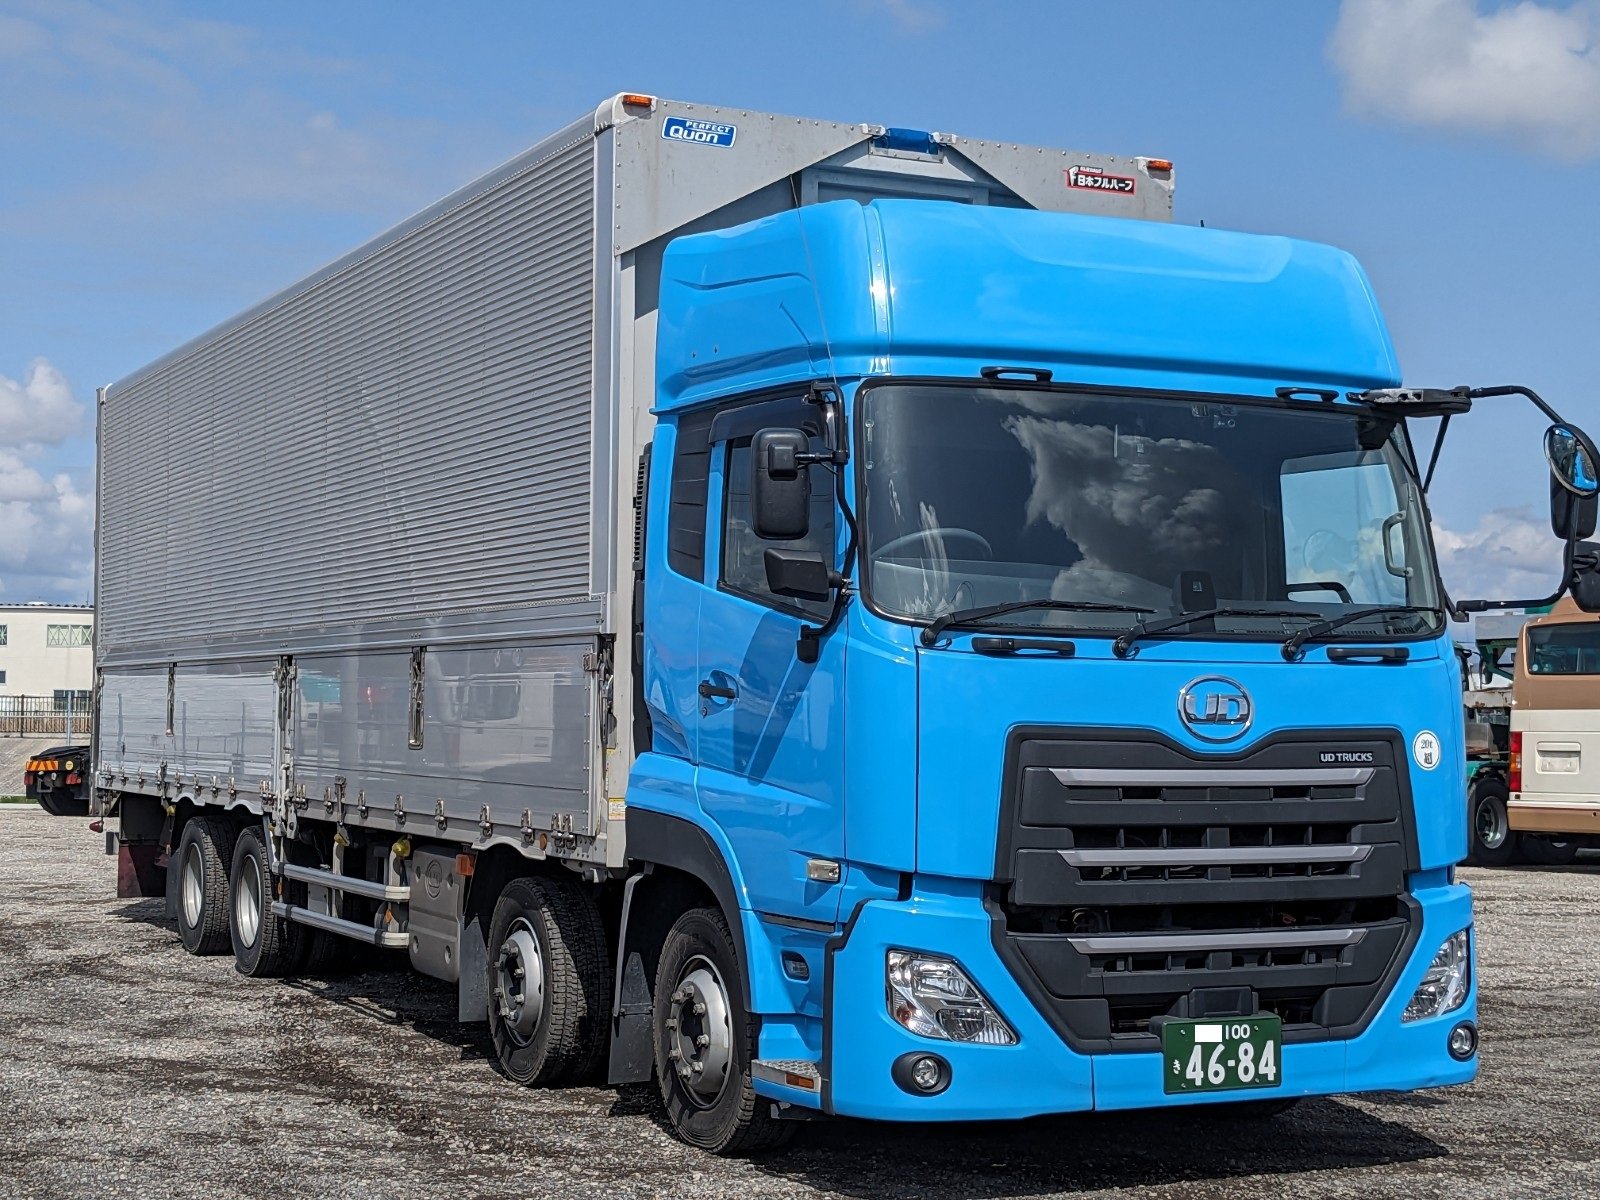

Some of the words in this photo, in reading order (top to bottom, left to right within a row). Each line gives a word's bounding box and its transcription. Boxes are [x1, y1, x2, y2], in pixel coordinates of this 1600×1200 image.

[686, 121, 731, 133] PERFECT
[1077, 175, 1133, 191] 日本フルハーフ
[1184, 693, 1249, 724] UD
[1320, 753, 1335, 762] UD
[1335, 752, 1373, 762] TRUCKS
[1225, 1024, 1251, 1040] 100
[1185, 1040, 1277, 1086] 46-84
